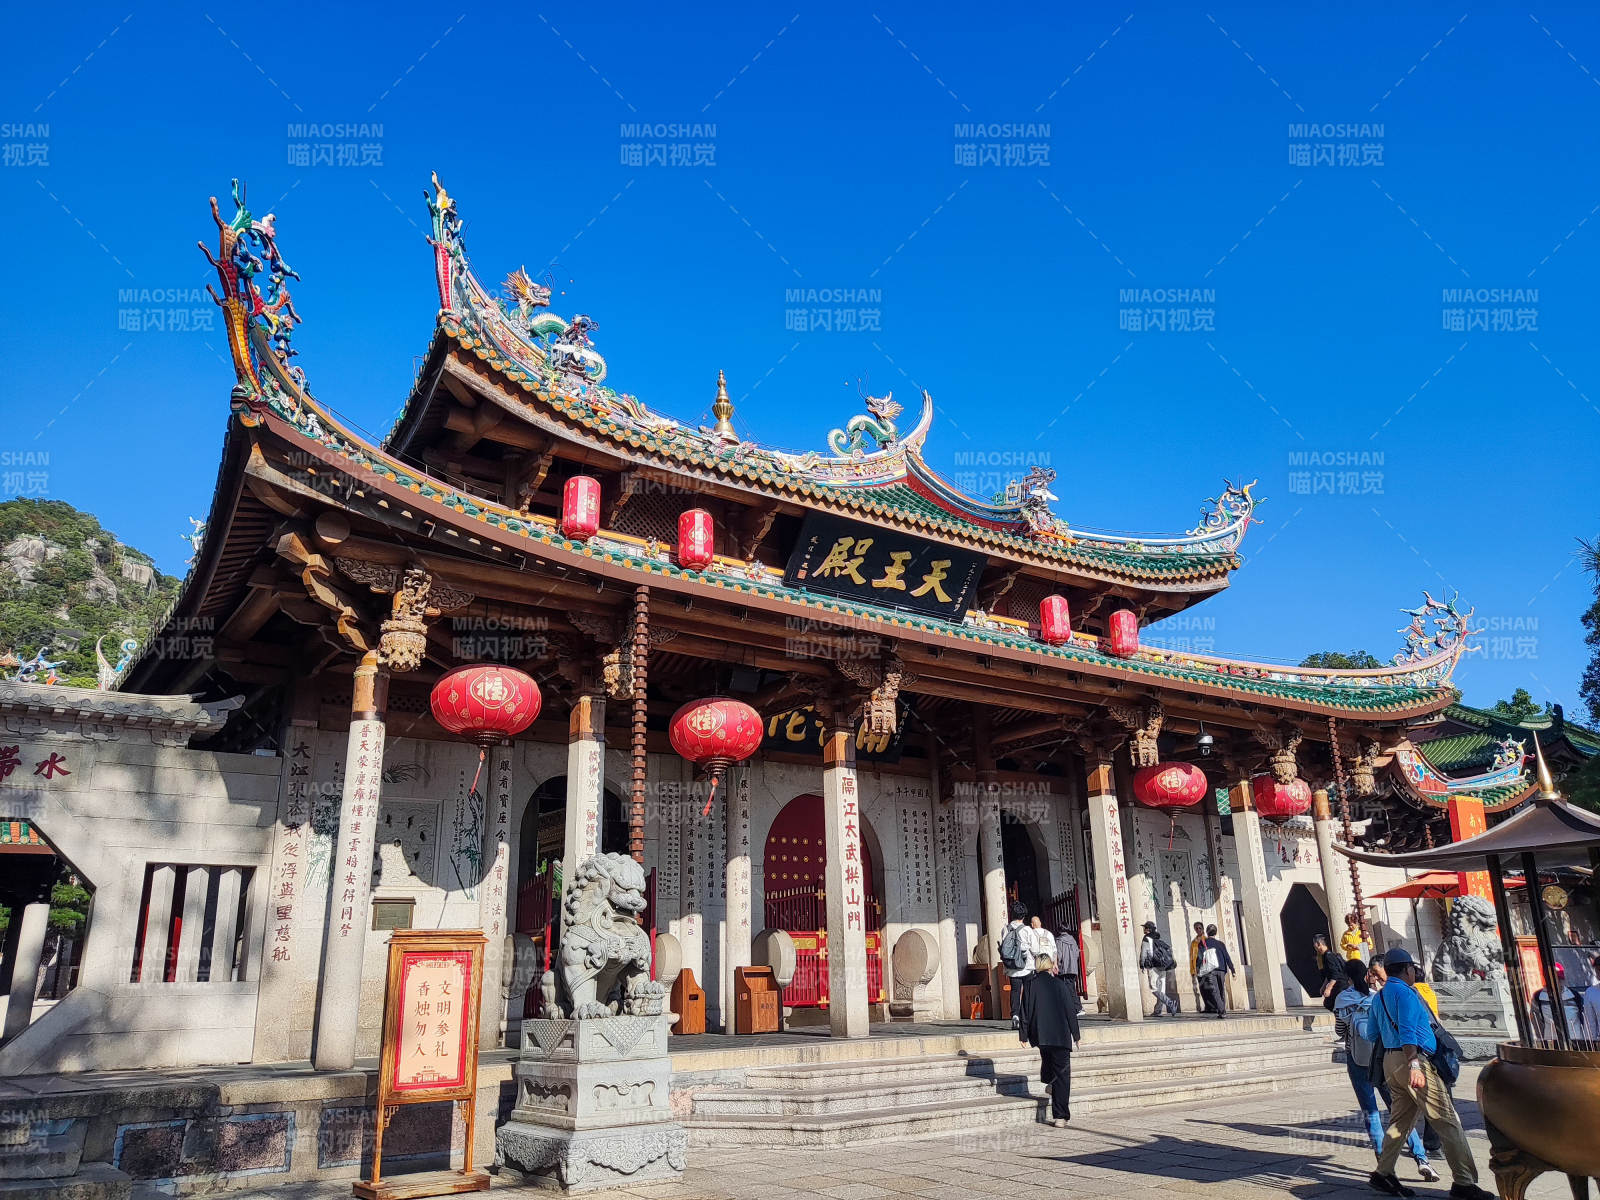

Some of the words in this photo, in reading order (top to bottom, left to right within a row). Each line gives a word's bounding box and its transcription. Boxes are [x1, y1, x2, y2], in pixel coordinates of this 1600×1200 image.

[812, 536, 953, 603] 天王殿
[413, 980, 431, 1058] 香烛勿入
[434, 980, 452, 1058] 文明参礼
